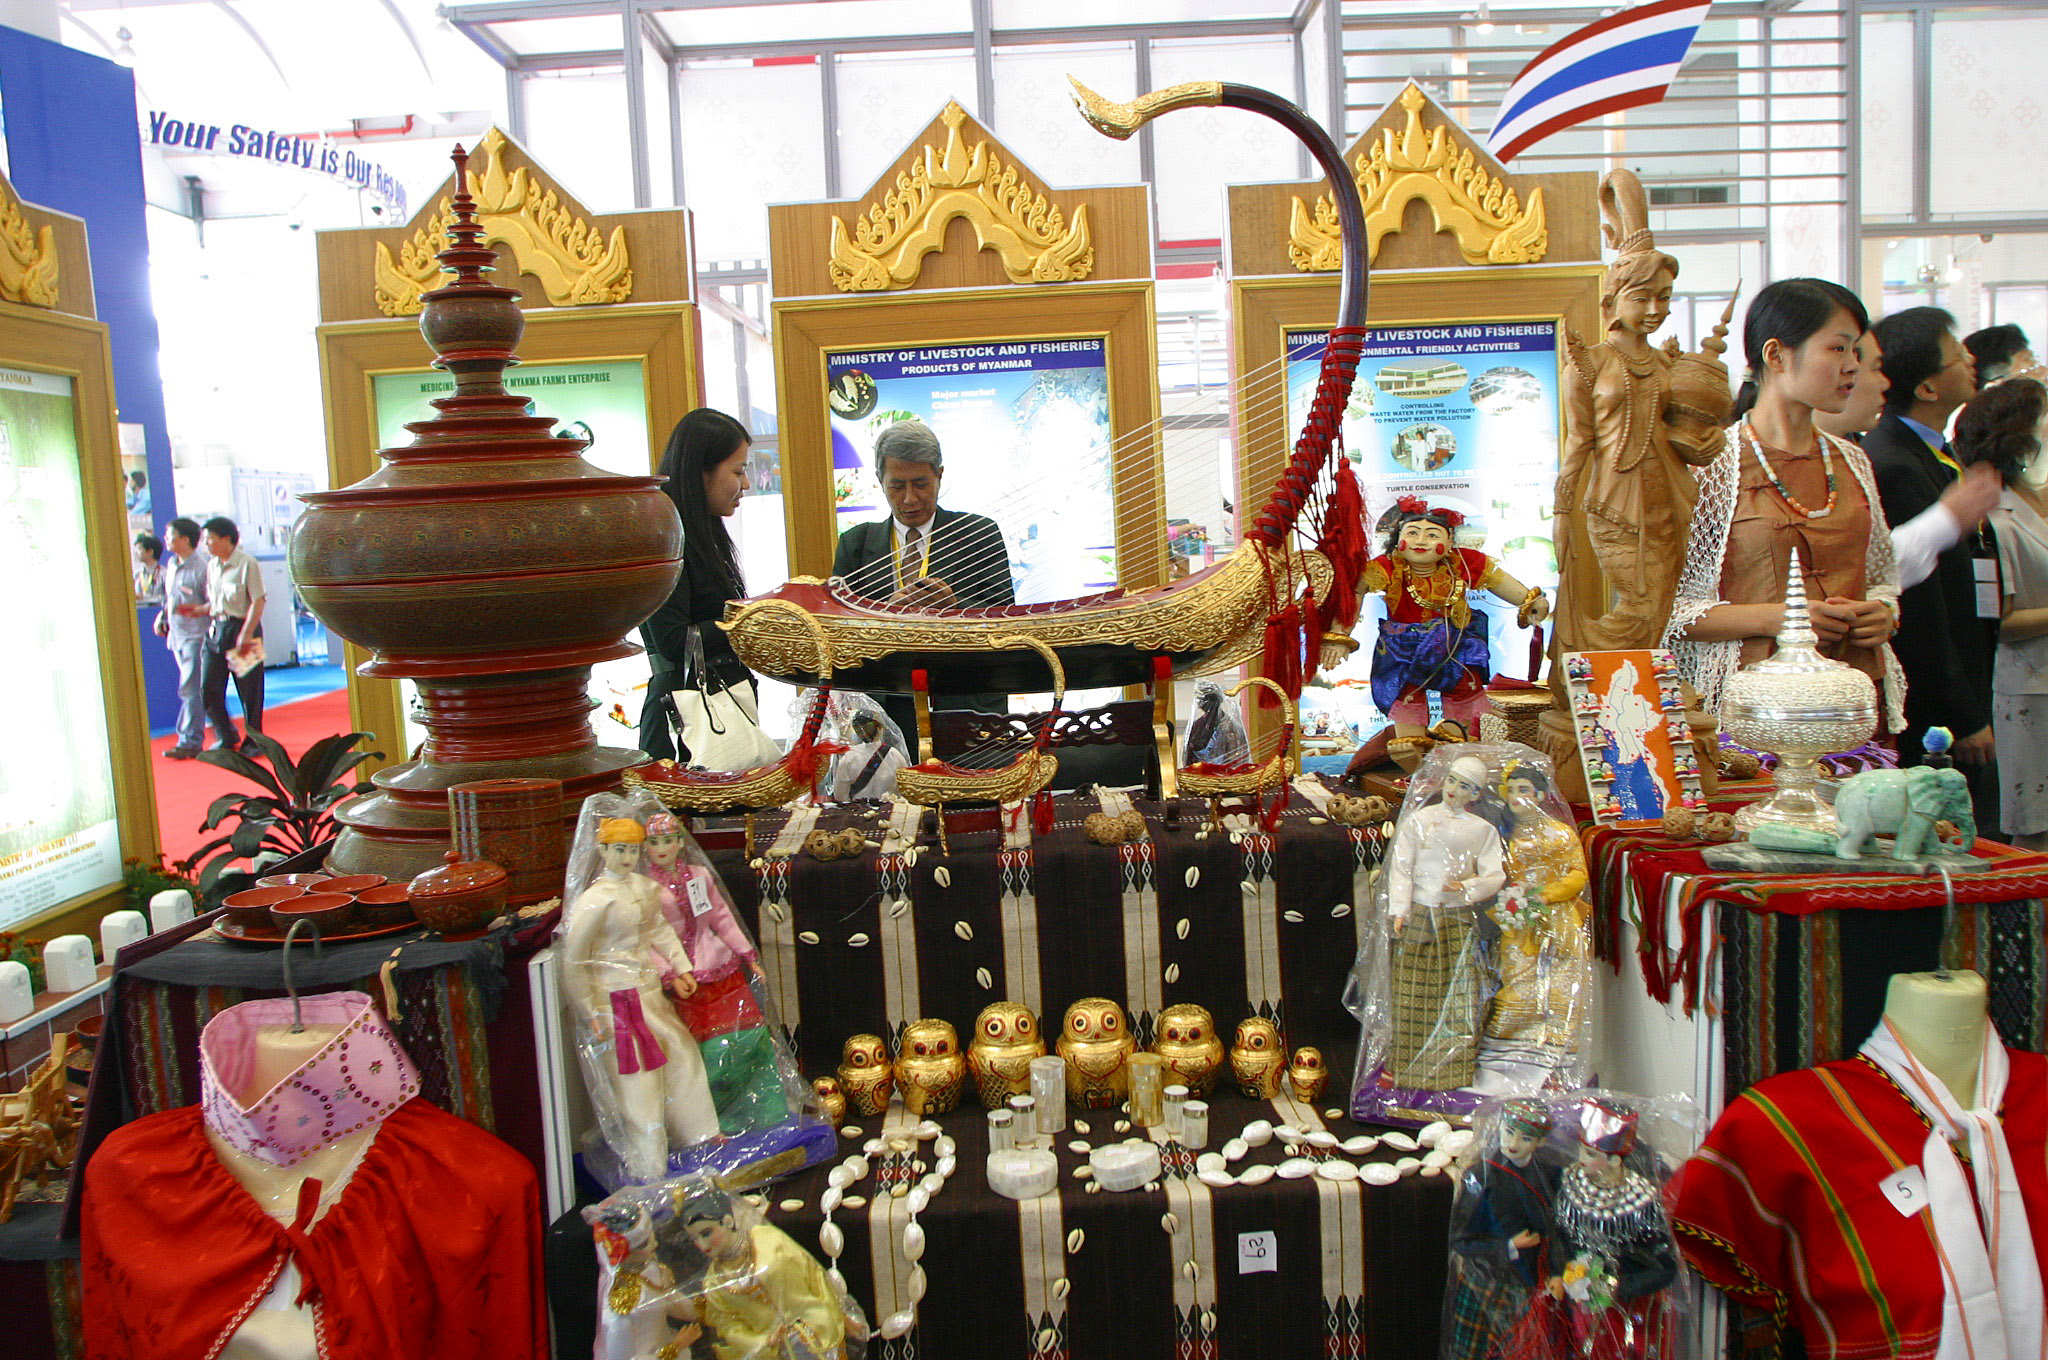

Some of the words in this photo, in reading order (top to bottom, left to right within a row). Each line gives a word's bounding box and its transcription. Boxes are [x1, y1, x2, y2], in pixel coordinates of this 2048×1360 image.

[149, 110, 221, 150] Your
[229, 124, 315, 169] Safety
[320, 142, 340, 174] is
[345, 150, 372, 186] Our
[1288, 333, 1334, 345] MINIST
[1376, 328, 1451, 342] LIVESTOCK
[1454, 327, 1482, 339] AND
[1485, 324, 1554, 337] FISHERIES
[830, 352, 895, 366] MINISTRY
[898, 351, 917, 362] OF
[920, 346, 995, 361] LIVESTOCK
[998, 344, 1027, 356] AND
[1030, 340, 1100, 354] FISHERIES
[1361, 346, 1414, 356] ONMENTAL
[1416, 344, 1463, 354] FRIENDLY
[1466, 342, 1520, 352] ACTIVITIES
[901, 363, 960, 375] PRODUCTS
[962, 362, 976, 372] OF
[978, 359, 1033, 371] MYANMAR
[420, 382, 454, 393] MEDICINE
[510, 376, 541, 388] MYANMA
[542, 374, 567, 385] FARMS
[568, 372, 611, 384] ENTERPRISE
[1436, 414, 1472, 422] POLLUTION
[1448, 407, 1476, 415] FACTORY
[1415, 483, 1470, 491] CONSERVATION
[1896, 1180, 1913, 1199] 5
